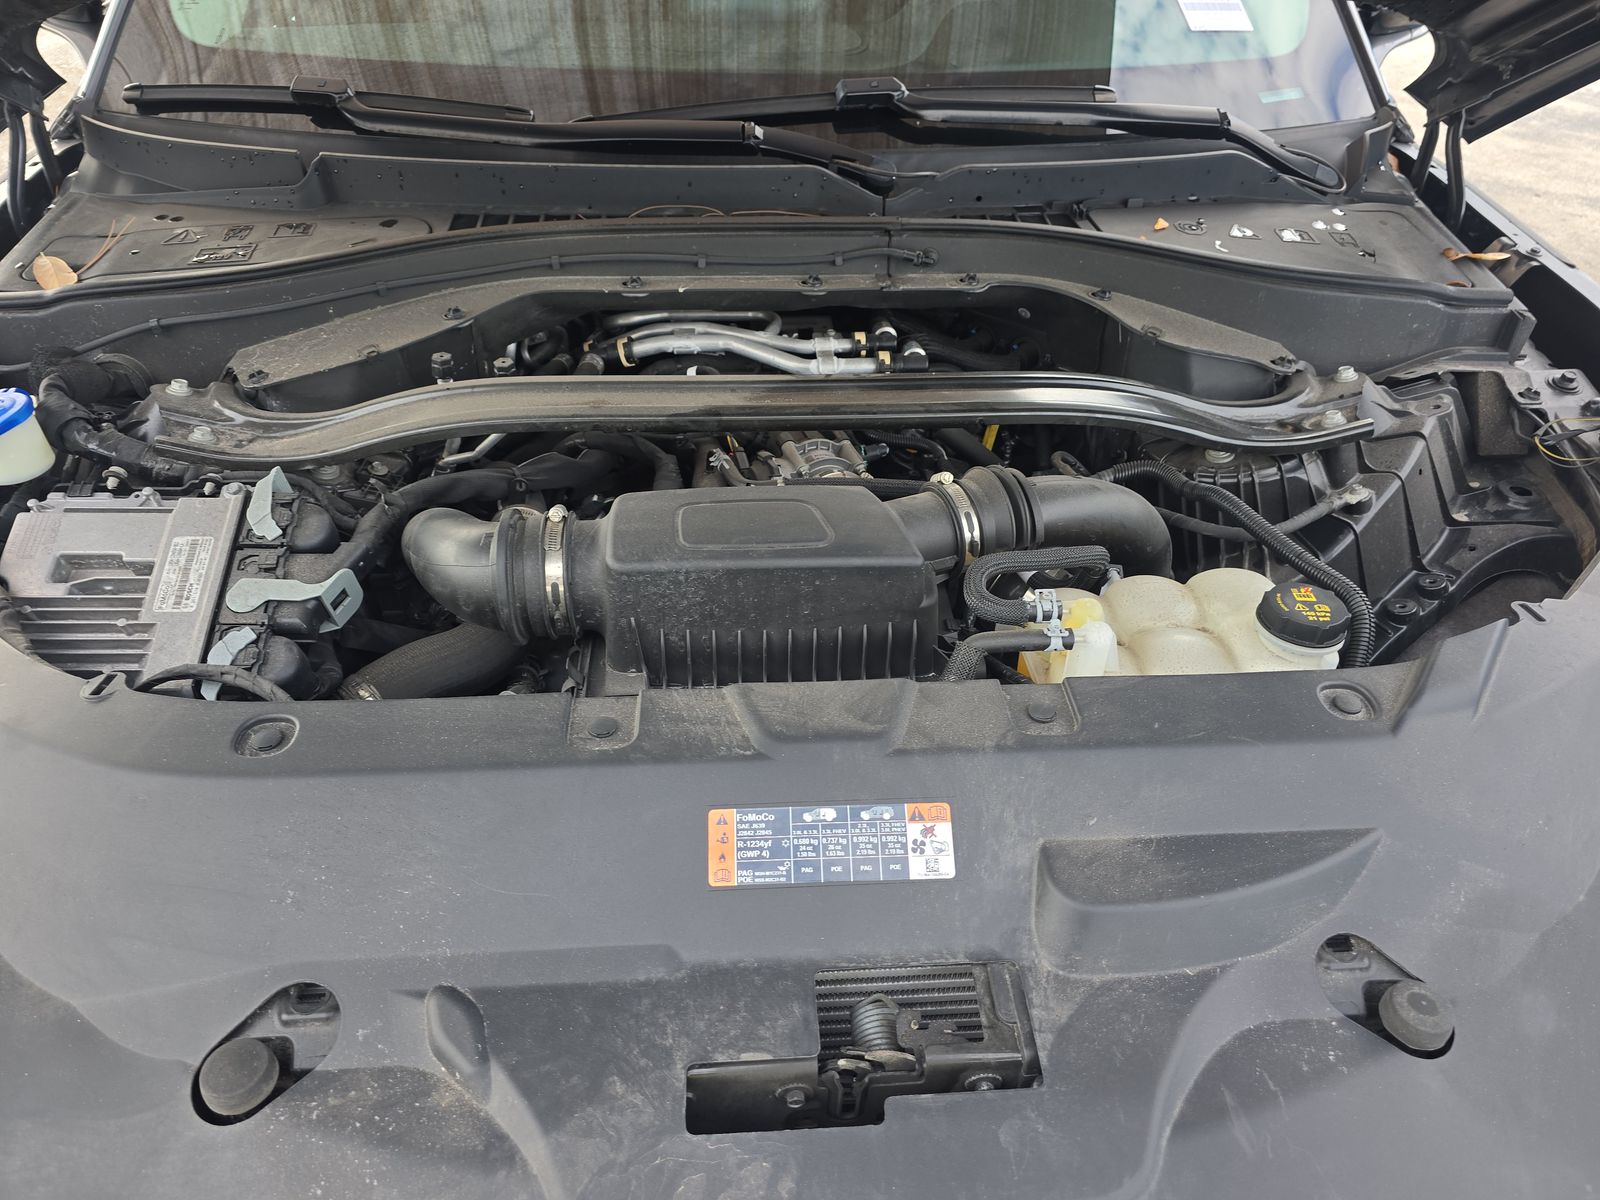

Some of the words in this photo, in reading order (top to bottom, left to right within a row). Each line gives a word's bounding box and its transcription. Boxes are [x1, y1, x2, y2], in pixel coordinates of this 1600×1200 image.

[736, 813, 775, 822] FoMoCo
[810, 838, 818, 846] kg
[838, 837, 847, 845] kg
[898, 835, 906, 843] kg
[737, 840, 772, 848] R-1234yf
[737, 850, 760, 859] (GWP
[761, 850, 770, 858] 4)
